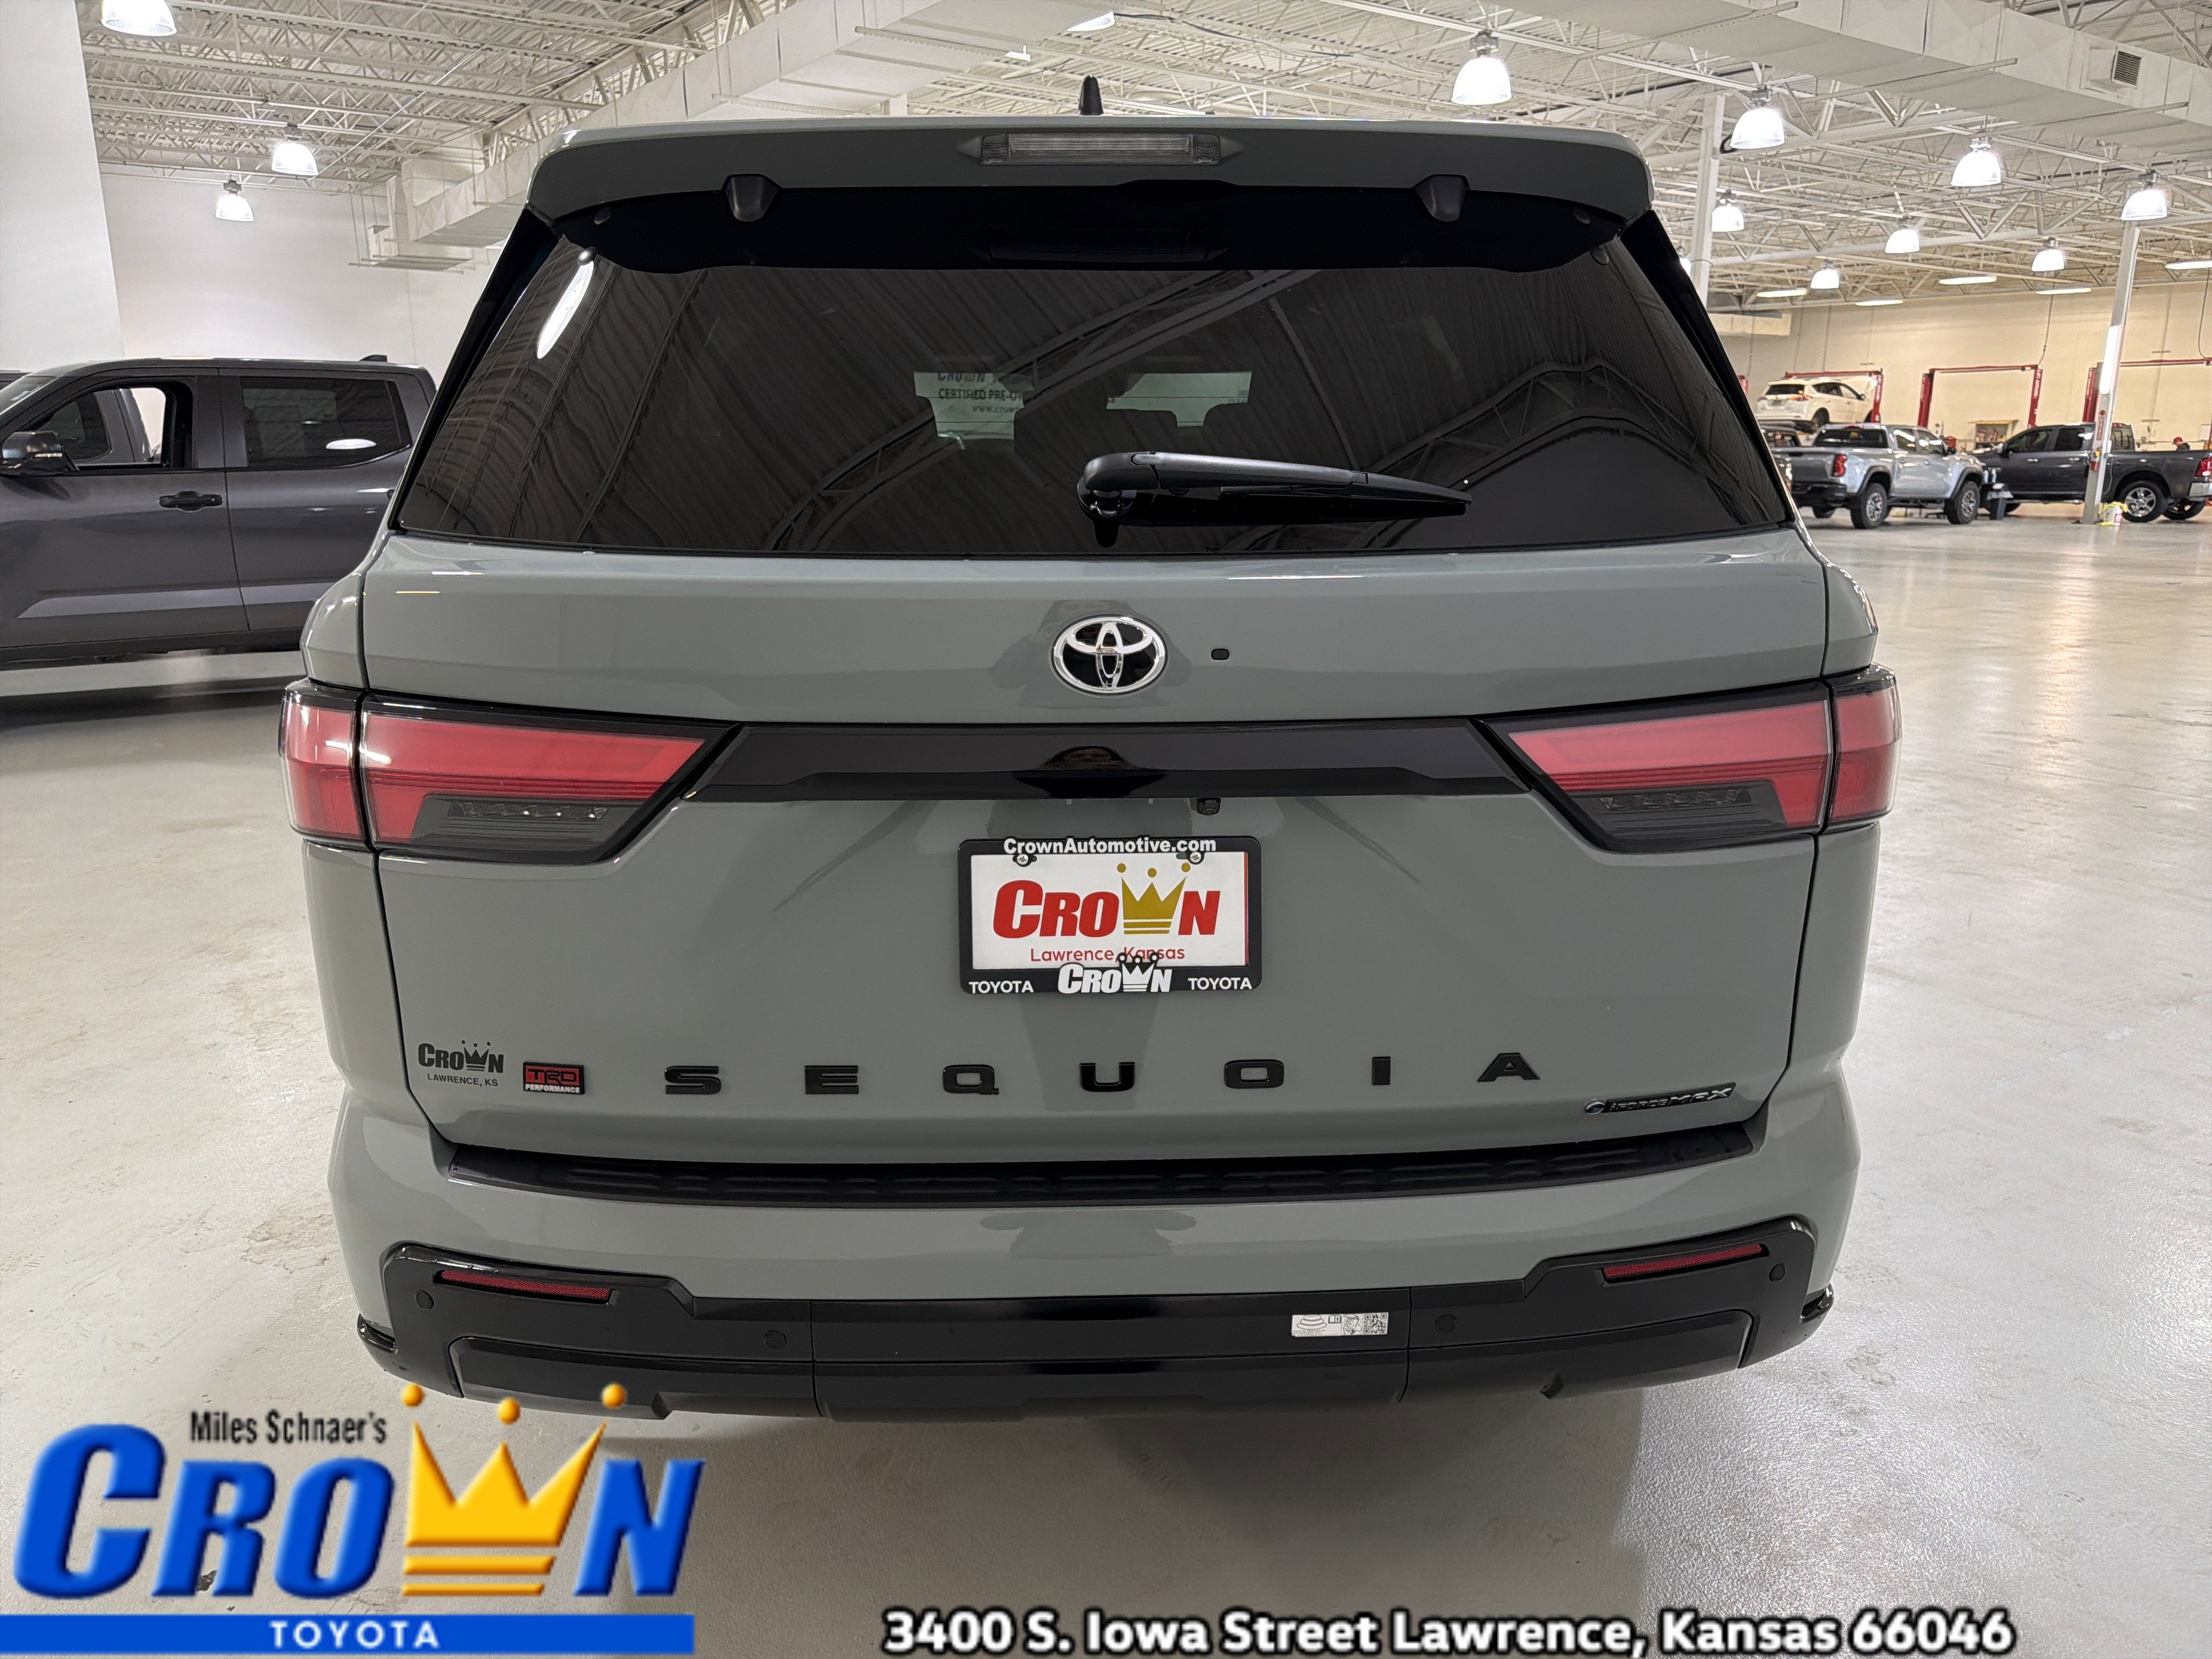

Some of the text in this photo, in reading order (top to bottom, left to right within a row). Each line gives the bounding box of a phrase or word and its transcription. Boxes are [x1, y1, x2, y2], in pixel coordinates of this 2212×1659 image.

[939, 388, 986, 399] CERTIFIED
[1003, 838, 1216, 854] CrownAutomotive.com
[993, 863, 1221, 939] CROWN
[1030, 946, 1185, 963] Lawrence, Kansas
[1057, 952, 1173, 994] CROWN
[969, 980, 1034, 994] TOYOTA
[1187, 977, 1252, 990] TOYOTA
[417, 1040, 504, 1074] CROWN
[427, 1073, 499, 1087] LAWRENCE, KS
[527, 1069, 579, 1085] TRD
[664, 1052, 1542, 1096] SEQUOIA
[524, 1083, 580, 1093] PERFORMANCE
